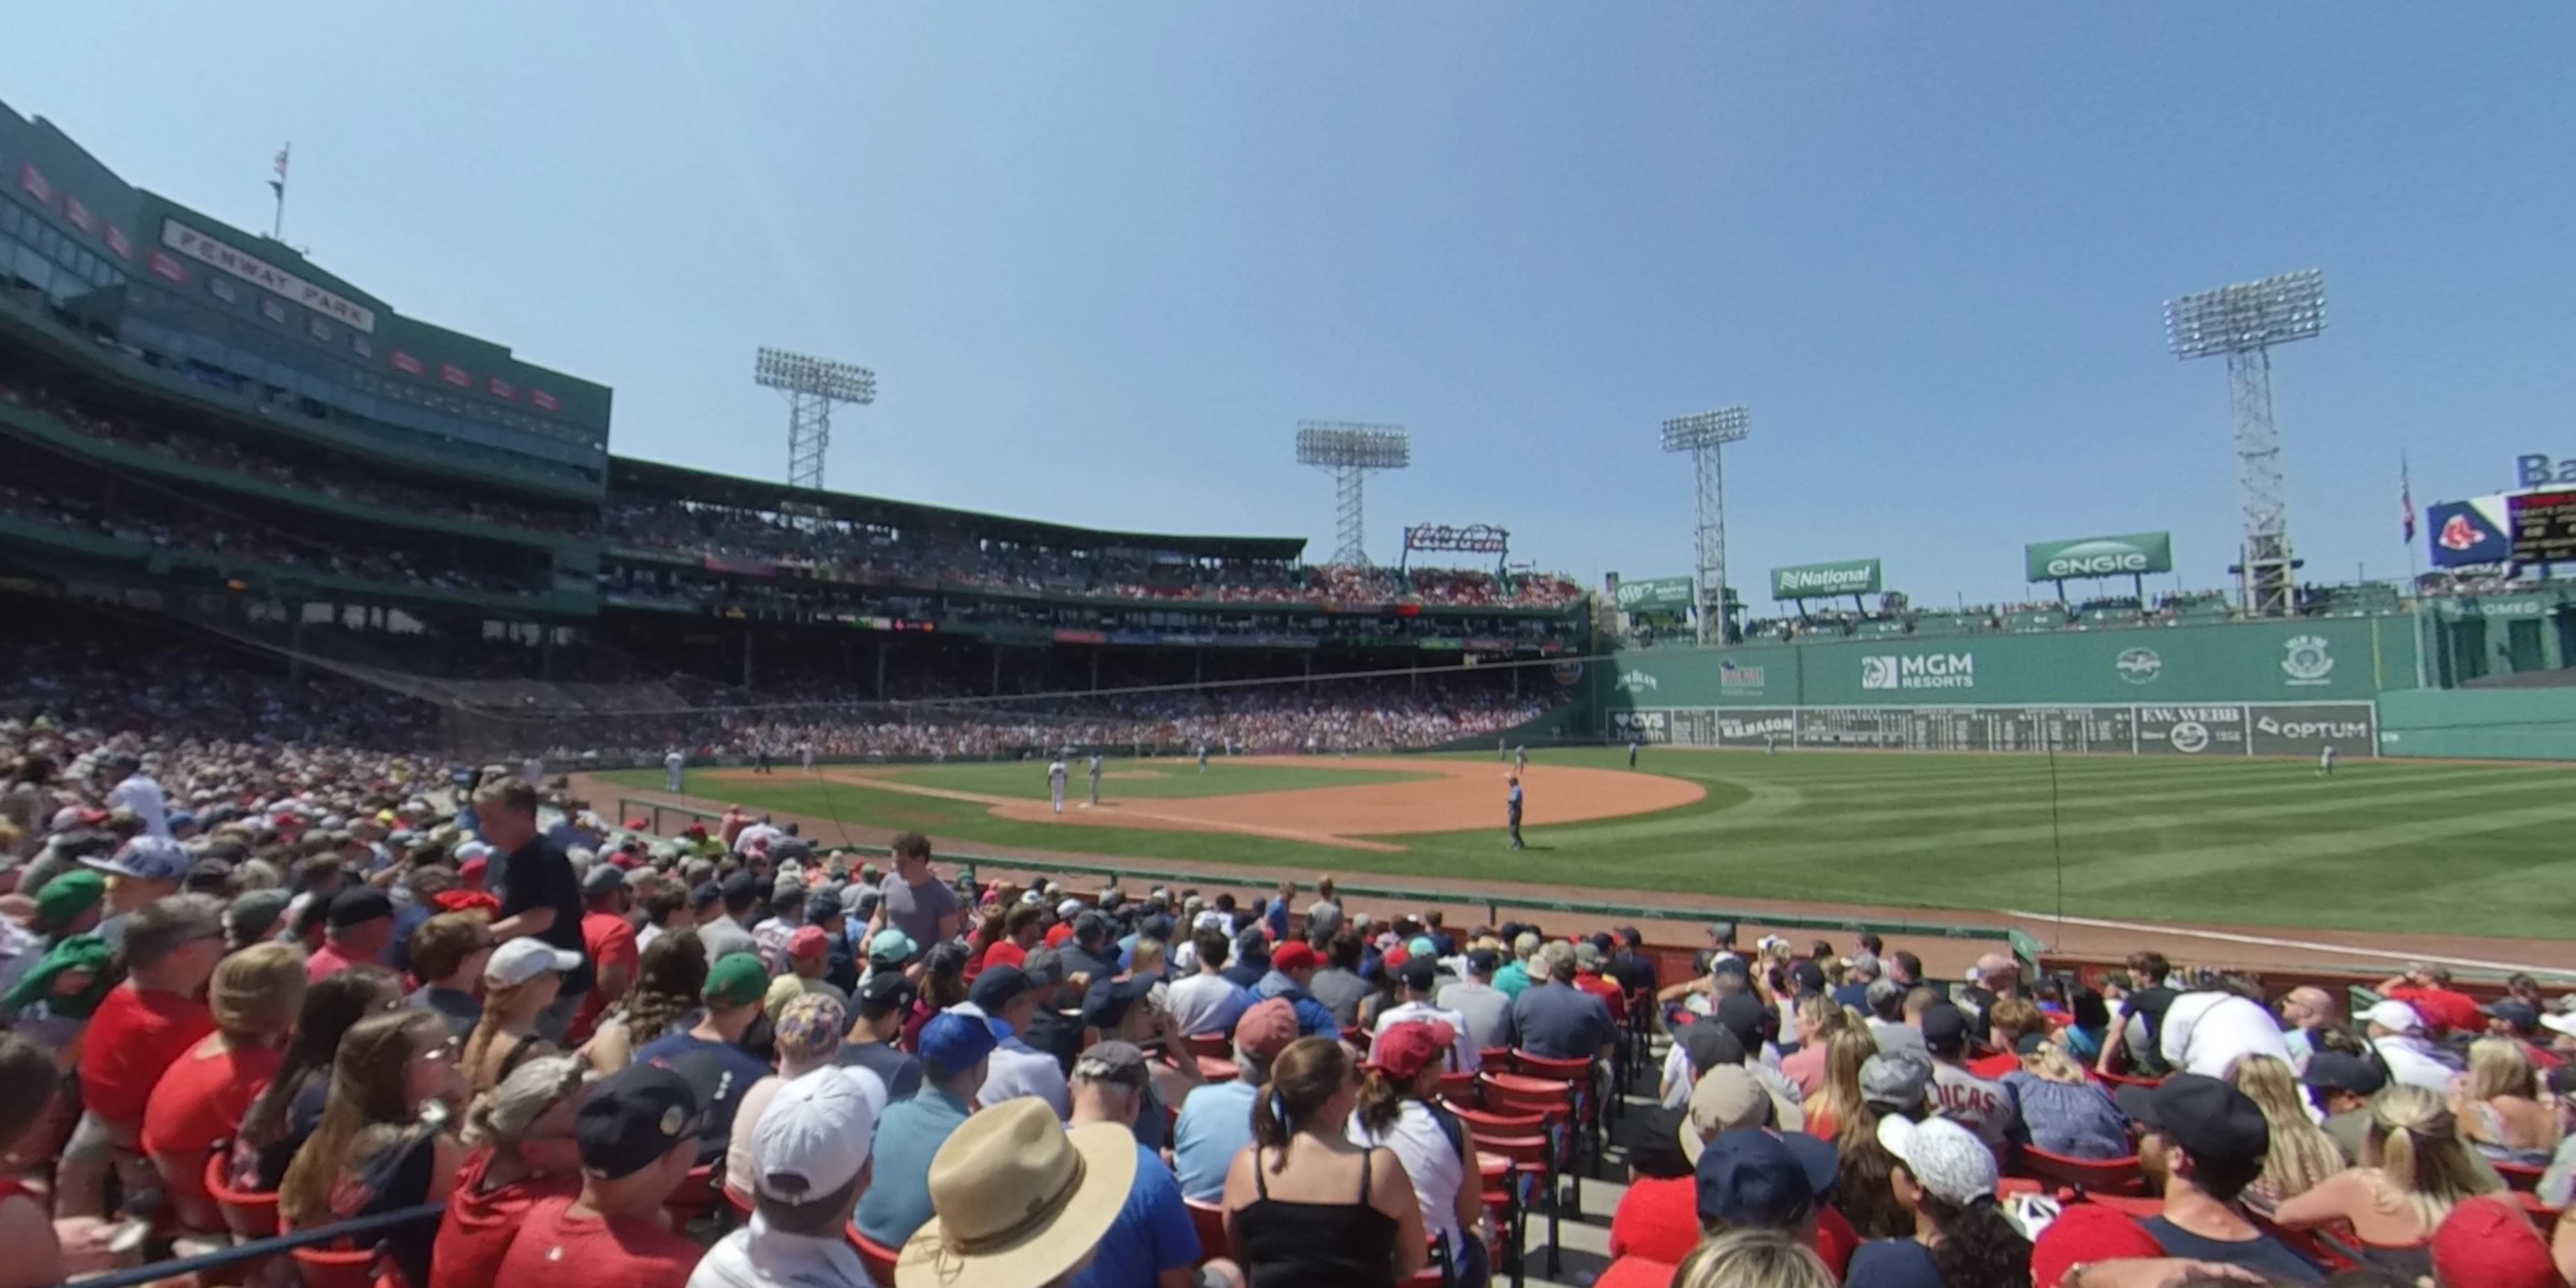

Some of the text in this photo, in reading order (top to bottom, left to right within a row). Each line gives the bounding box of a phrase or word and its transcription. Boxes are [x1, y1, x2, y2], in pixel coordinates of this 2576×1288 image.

[180, 231, 288, 288] FENWAY
[303, 287, 361, 323] PARK
[1800, 565, 1870, 586] National
[1901, 652, 1972, 676] MGM
[1632, 669, 1657, 690] BEAM
[1902, 675, 1974, 688] RESORTS
[1630, 713, 1664, 728] CVS
[2180, 707, 2240, 721] WEBB
[1746, 718, 1792, 736] MASON
[2282, 722, 2366, 739] OPTUM
